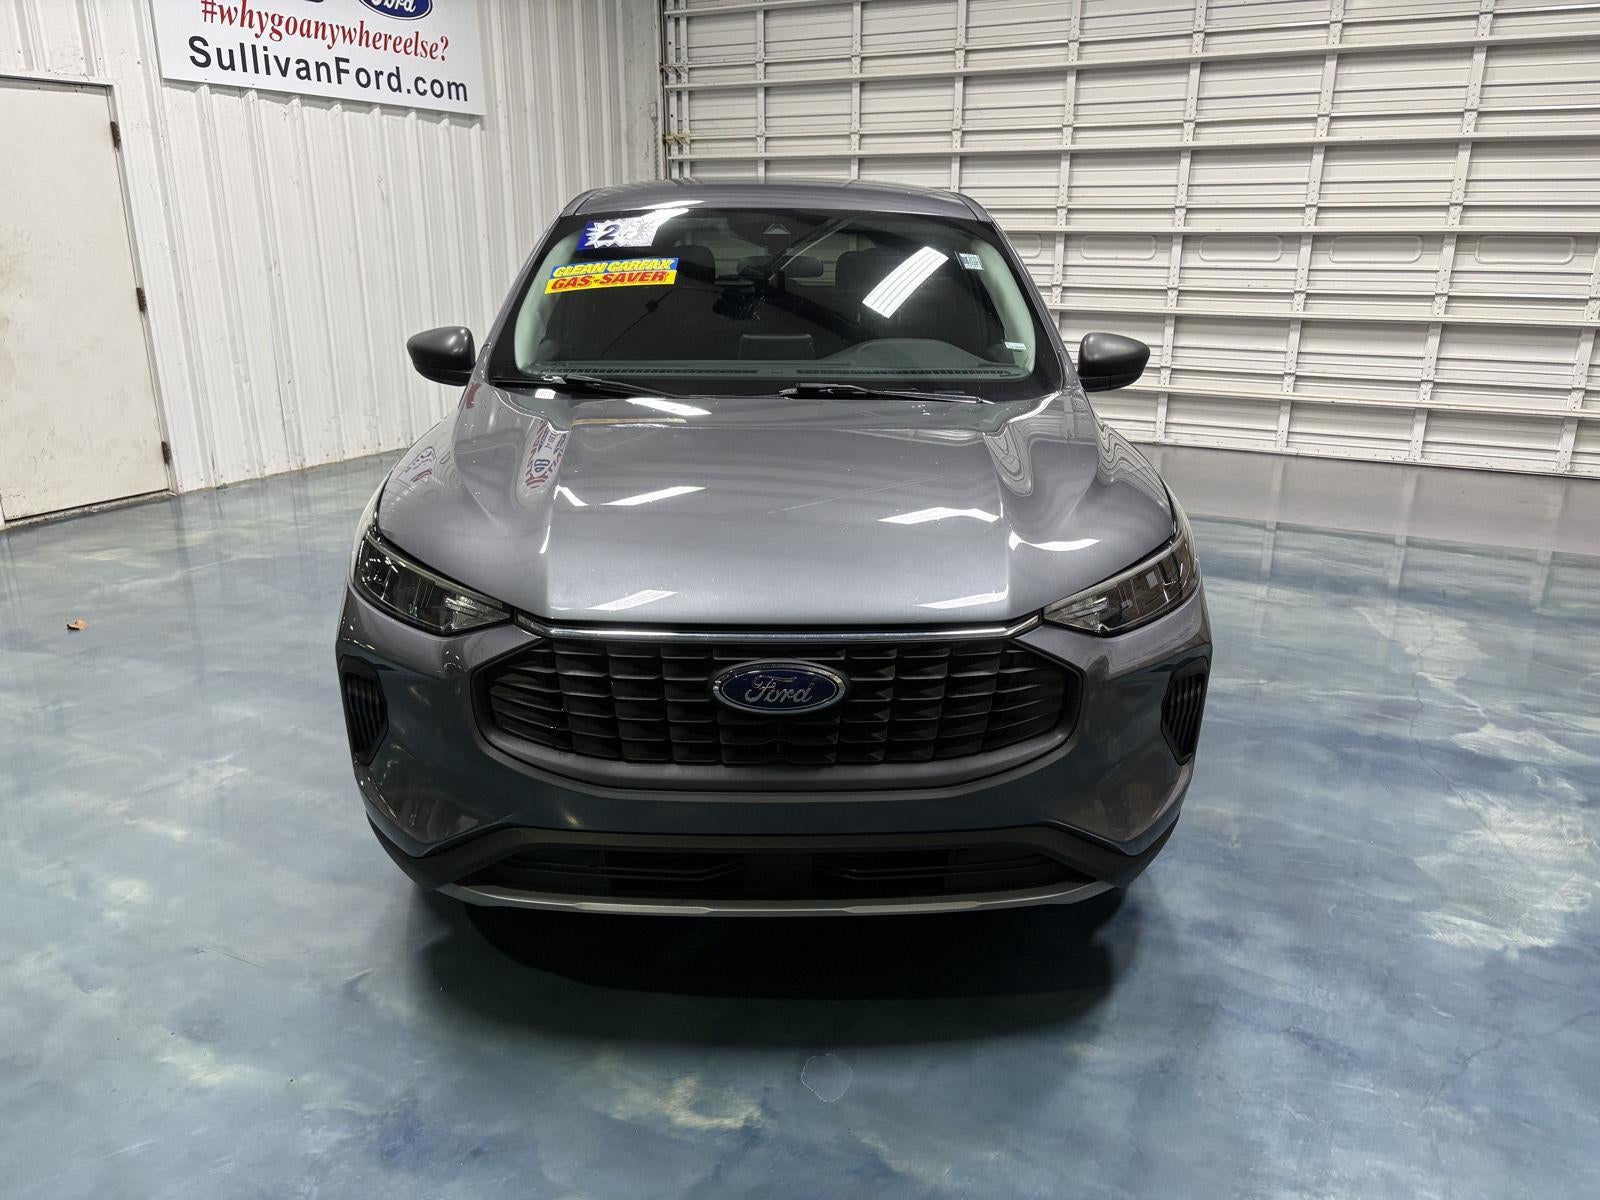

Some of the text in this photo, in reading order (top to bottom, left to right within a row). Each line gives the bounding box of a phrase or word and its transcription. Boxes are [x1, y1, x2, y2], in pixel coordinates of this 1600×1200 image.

[201, 0, 449, 61] #whygoanywhereelse?
[189, 36, 468, 102] SullivanFord.com
[551, 271, 667, 289] GAS-SAVER
[553, 259, 673, 277] CLEAN CARFAX
[744, 674, 815, 703] Ford
